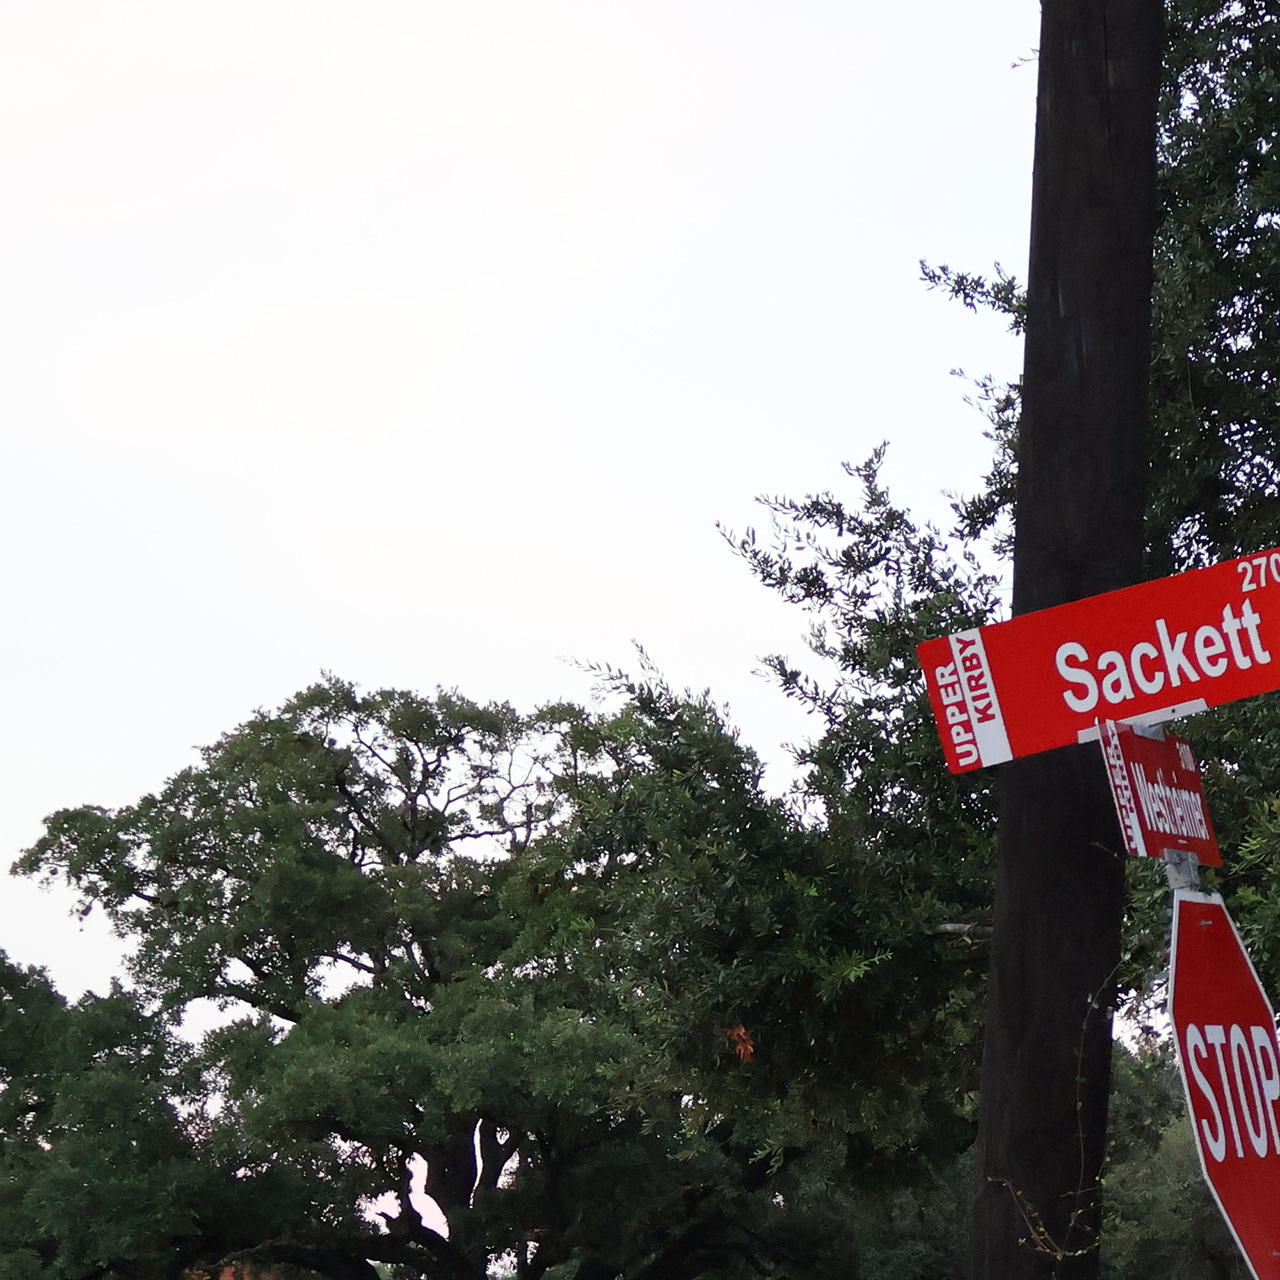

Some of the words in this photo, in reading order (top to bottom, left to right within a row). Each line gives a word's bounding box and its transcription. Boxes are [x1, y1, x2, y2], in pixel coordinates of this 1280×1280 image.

[955, 634, 999, 724] KIRBY
[1055, 598, 1272, 713] Sackett
[935, 661, 979, 767] UPPER
[1130, 761, 1209, 840] Westheimer
